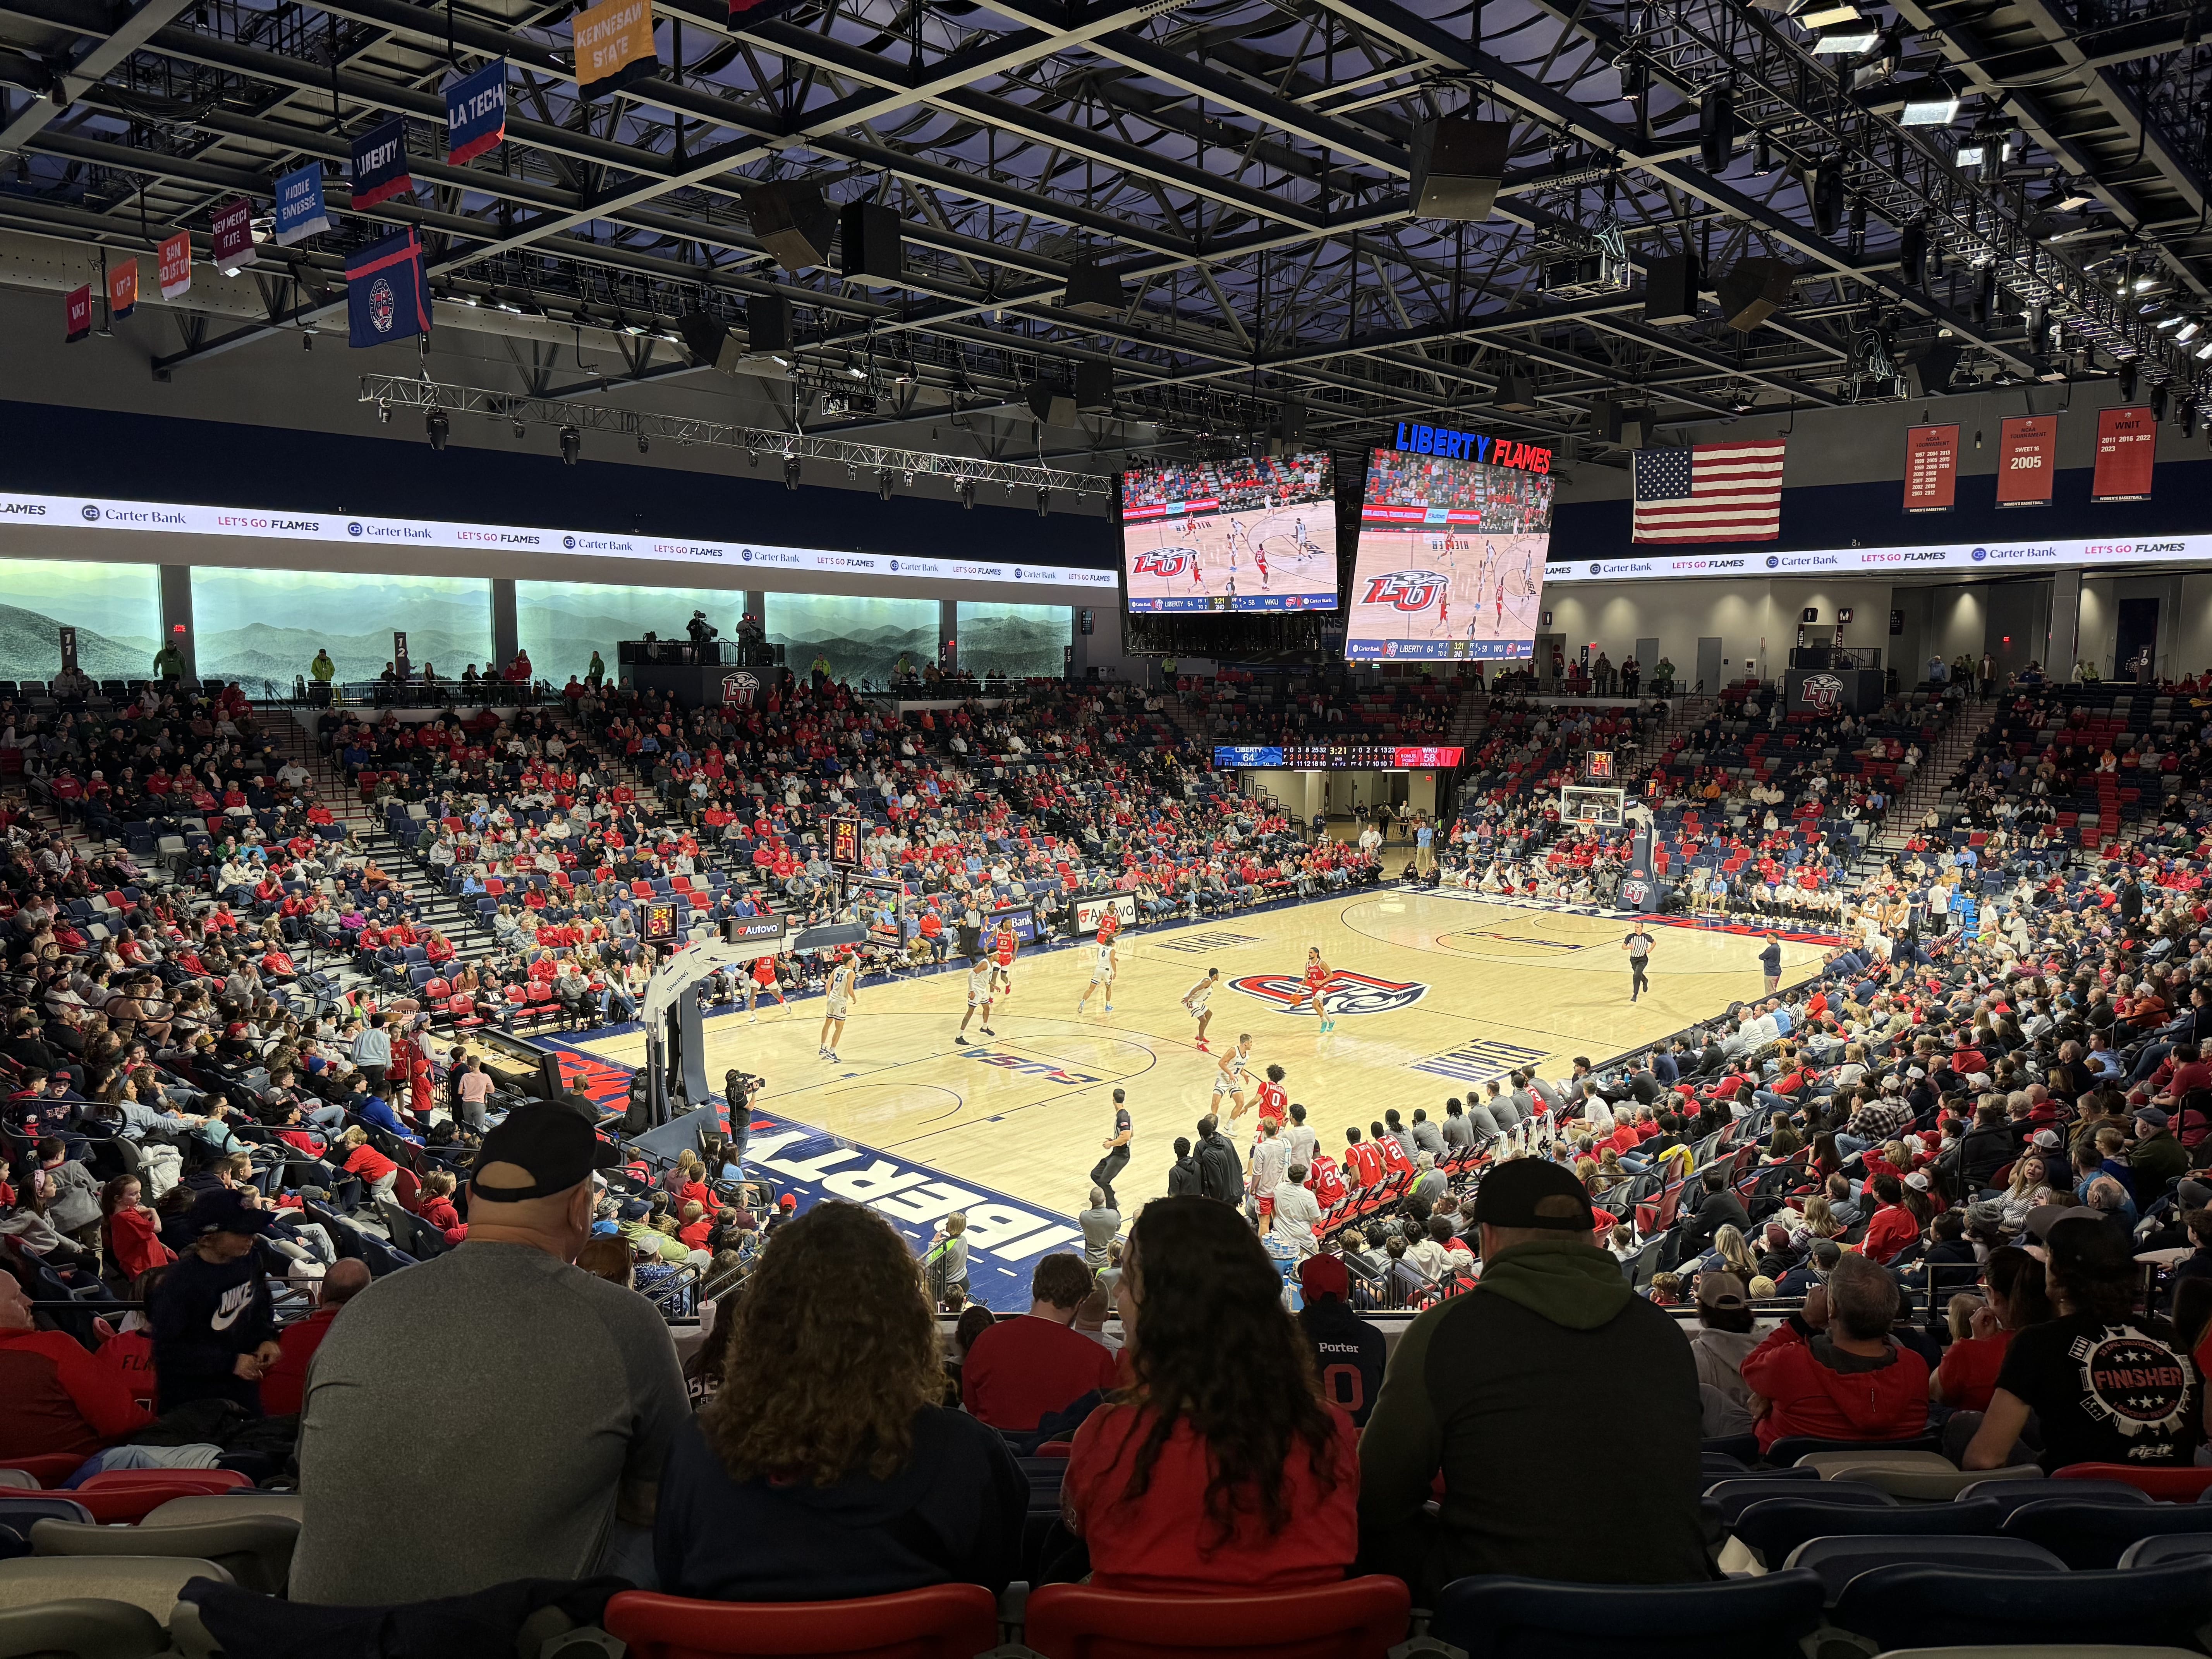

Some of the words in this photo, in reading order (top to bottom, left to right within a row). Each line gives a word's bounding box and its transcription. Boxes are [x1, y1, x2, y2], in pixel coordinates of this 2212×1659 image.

[577, 3, 644, 48] KENNESAW
[592, 36, 629, 69] STATE
[450, 103, 467, 129] LA
[466, 82, 505, 121] TECH
[357, 138, 398, 179] LIBERTY
[285, 179, 309, 201] MIDDLE
[282, 193, 316, 220] ENNESSEE
[2115, 421, 2141, 429] WNIT
[1396, 422, 1490, 462] LIBERTY
[1492, 439, 1552, 474] FLAMES
[2010, 456, 2041, 469] 2005
[106, 509, 148, 522] Carter
[152, 511, 187, 524] Bank
[218, 516, 248, 527] LET'S
[251, 519, 267, 528] GO
[271, 520, 319, 531] FLAMES
[367, 526, 402, 537] Carter
[404, 527, 432, 539] Bank
[457, 531, 482, 541] LET'S
[484, 533, 497, 541] GO
[500, 534, 540, 544] FLAMES
[579, 539, 607, 550] Carter
[610, 541, 633, 551] Bank
[654, 545, 675, 554] LET'S
[676, 546, 687, 554] GO
[690, 547, 723, 557] FLAMES
[2085, 546, 2113, 555] LET'S
[2116, 545, 2131, 553] GO
[2135, 543, 2185, 553] FLAMES
[755, 552, 779, 562] Carter
[780, 554, 800, 563] Bank
[1862, 554, 1884, 563] LET'S
[1904, 552, 1946, 561] FLAMES
[1990, 548, 2024, 558] Carter
[2028, 546, 2057, 557] Bank
[847, 559, 874, 568] FLAMES
[901, 562, 921, 571] Carter
[922, 563, 938, 572] Bank
[1708, 560, 1744, 568] FLAMES
[1781, 557, 1810, 566] Carter
[1813, 555, 1838, 564] Bank
[978, 568, 1001, 576] FLAMES
[1024, 570, 1041, 578] Carter
[1603, 564, 1627, 573] Carter
[1631, 562, 1652, 572] Bank
[1243, 753, 1254, 762] 64
[1424, 754, 1435, 762] 58
[1592, 762, 1608, 775] 27
[839, 823, 856, 836] 3:21
[837, 836, 853, 859] 27
[653, 909, 672, 920] 3:21
[1091, 905, 1133, 922] Ava
[1012, 914, 1033, 927] Bank
[652, 921, 668, 935] 27
[745, 924, 778, 935] Autova
[666, 970, 689, 993] SPALDING
[836, 973, 843, 982] 25
[488, 992, 501, 1003] 18
[1271, 1092, 1280, 1107] 0
[1531, 1091, 1541, 1101] 3
[1389, 1144, 1405, 1160] 21
[1367, 1152, 1375, 1167] 1
[1324, 1167, 1341, 1187] 24
[221, 1281, 252, 1314] NIKE
[1319, 1342, 1359, 1353] Porter
[2094, 1367, 2183, 1389] FINISHER
[1323, 1364, 1364, 1411] 0
